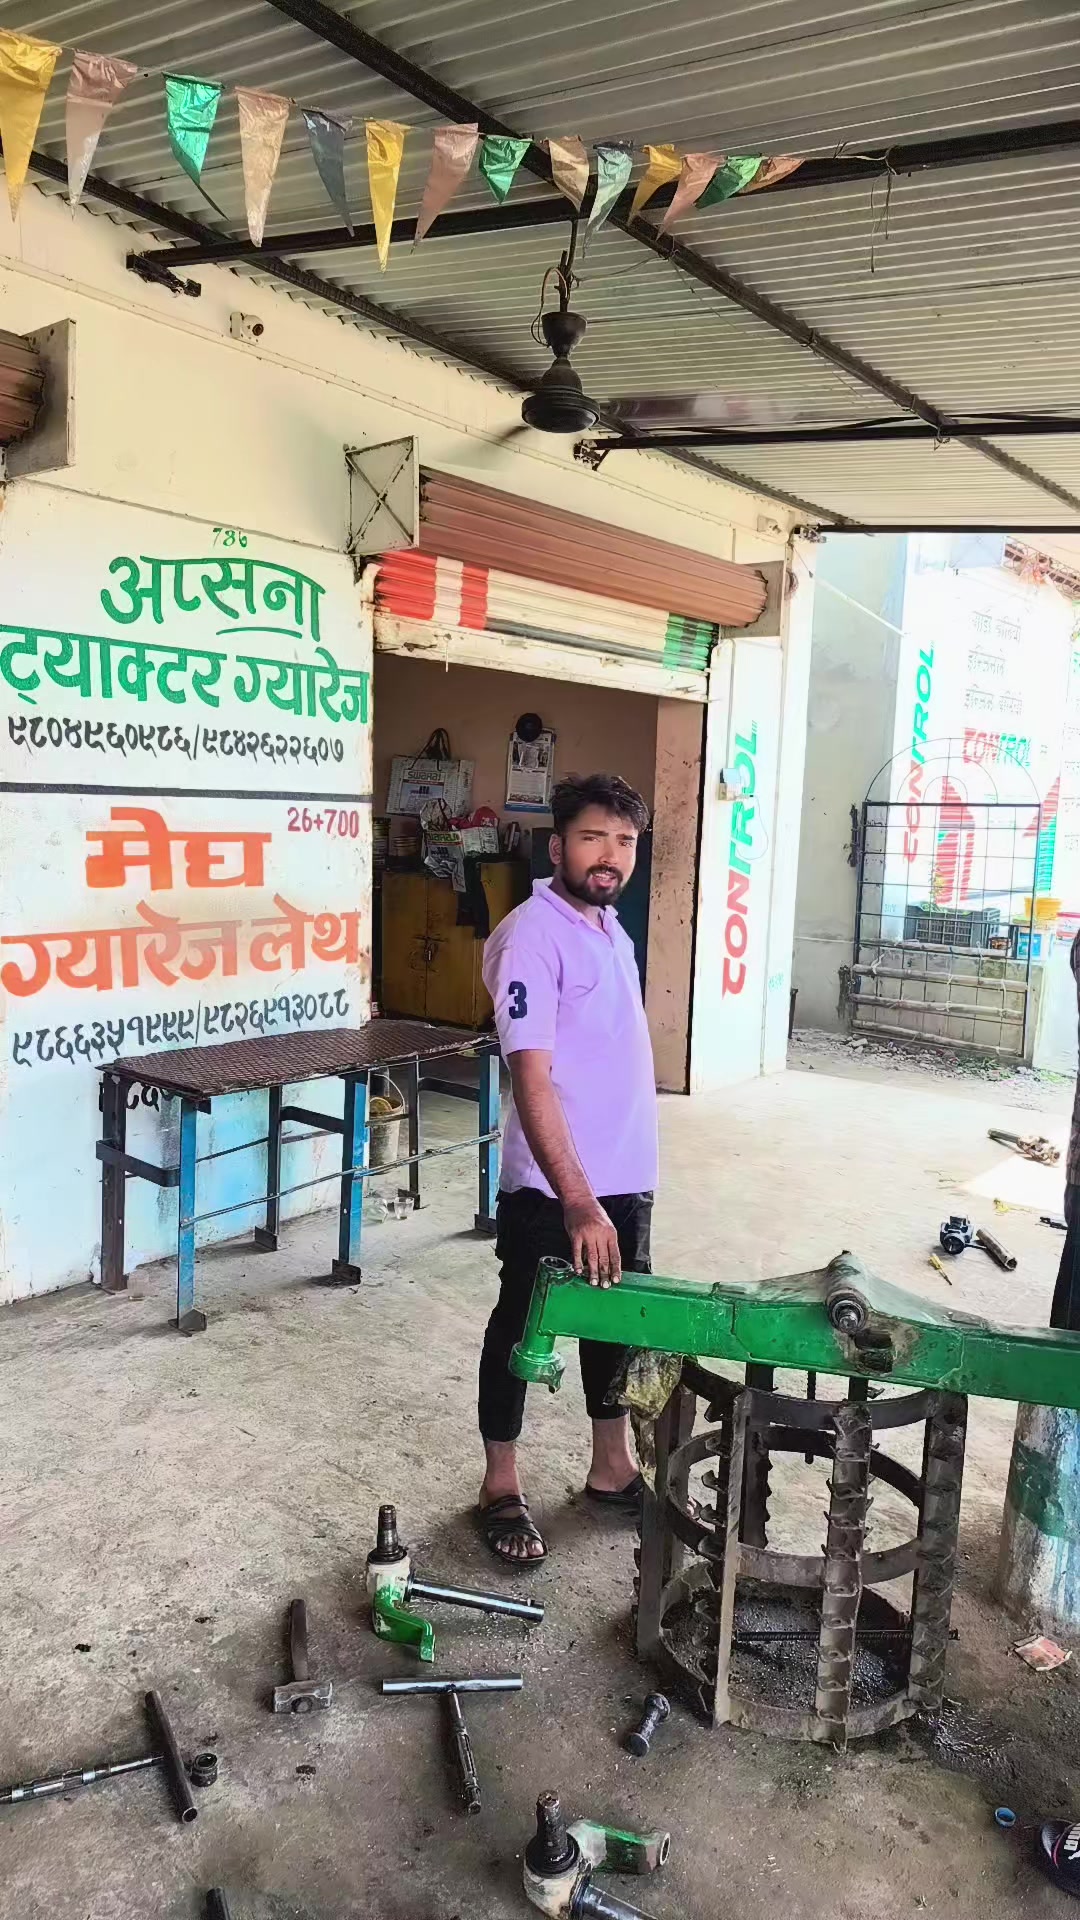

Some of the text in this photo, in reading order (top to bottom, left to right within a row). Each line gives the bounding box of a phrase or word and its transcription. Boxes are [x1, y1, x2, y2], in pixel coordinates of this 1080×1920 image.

[904, 647, 934, 864] CONTROL
[287, 806, 360, 838] 26+700
[722, 732, 757, 1000] CONTROL
[508, 981, 528, 1020] 3
